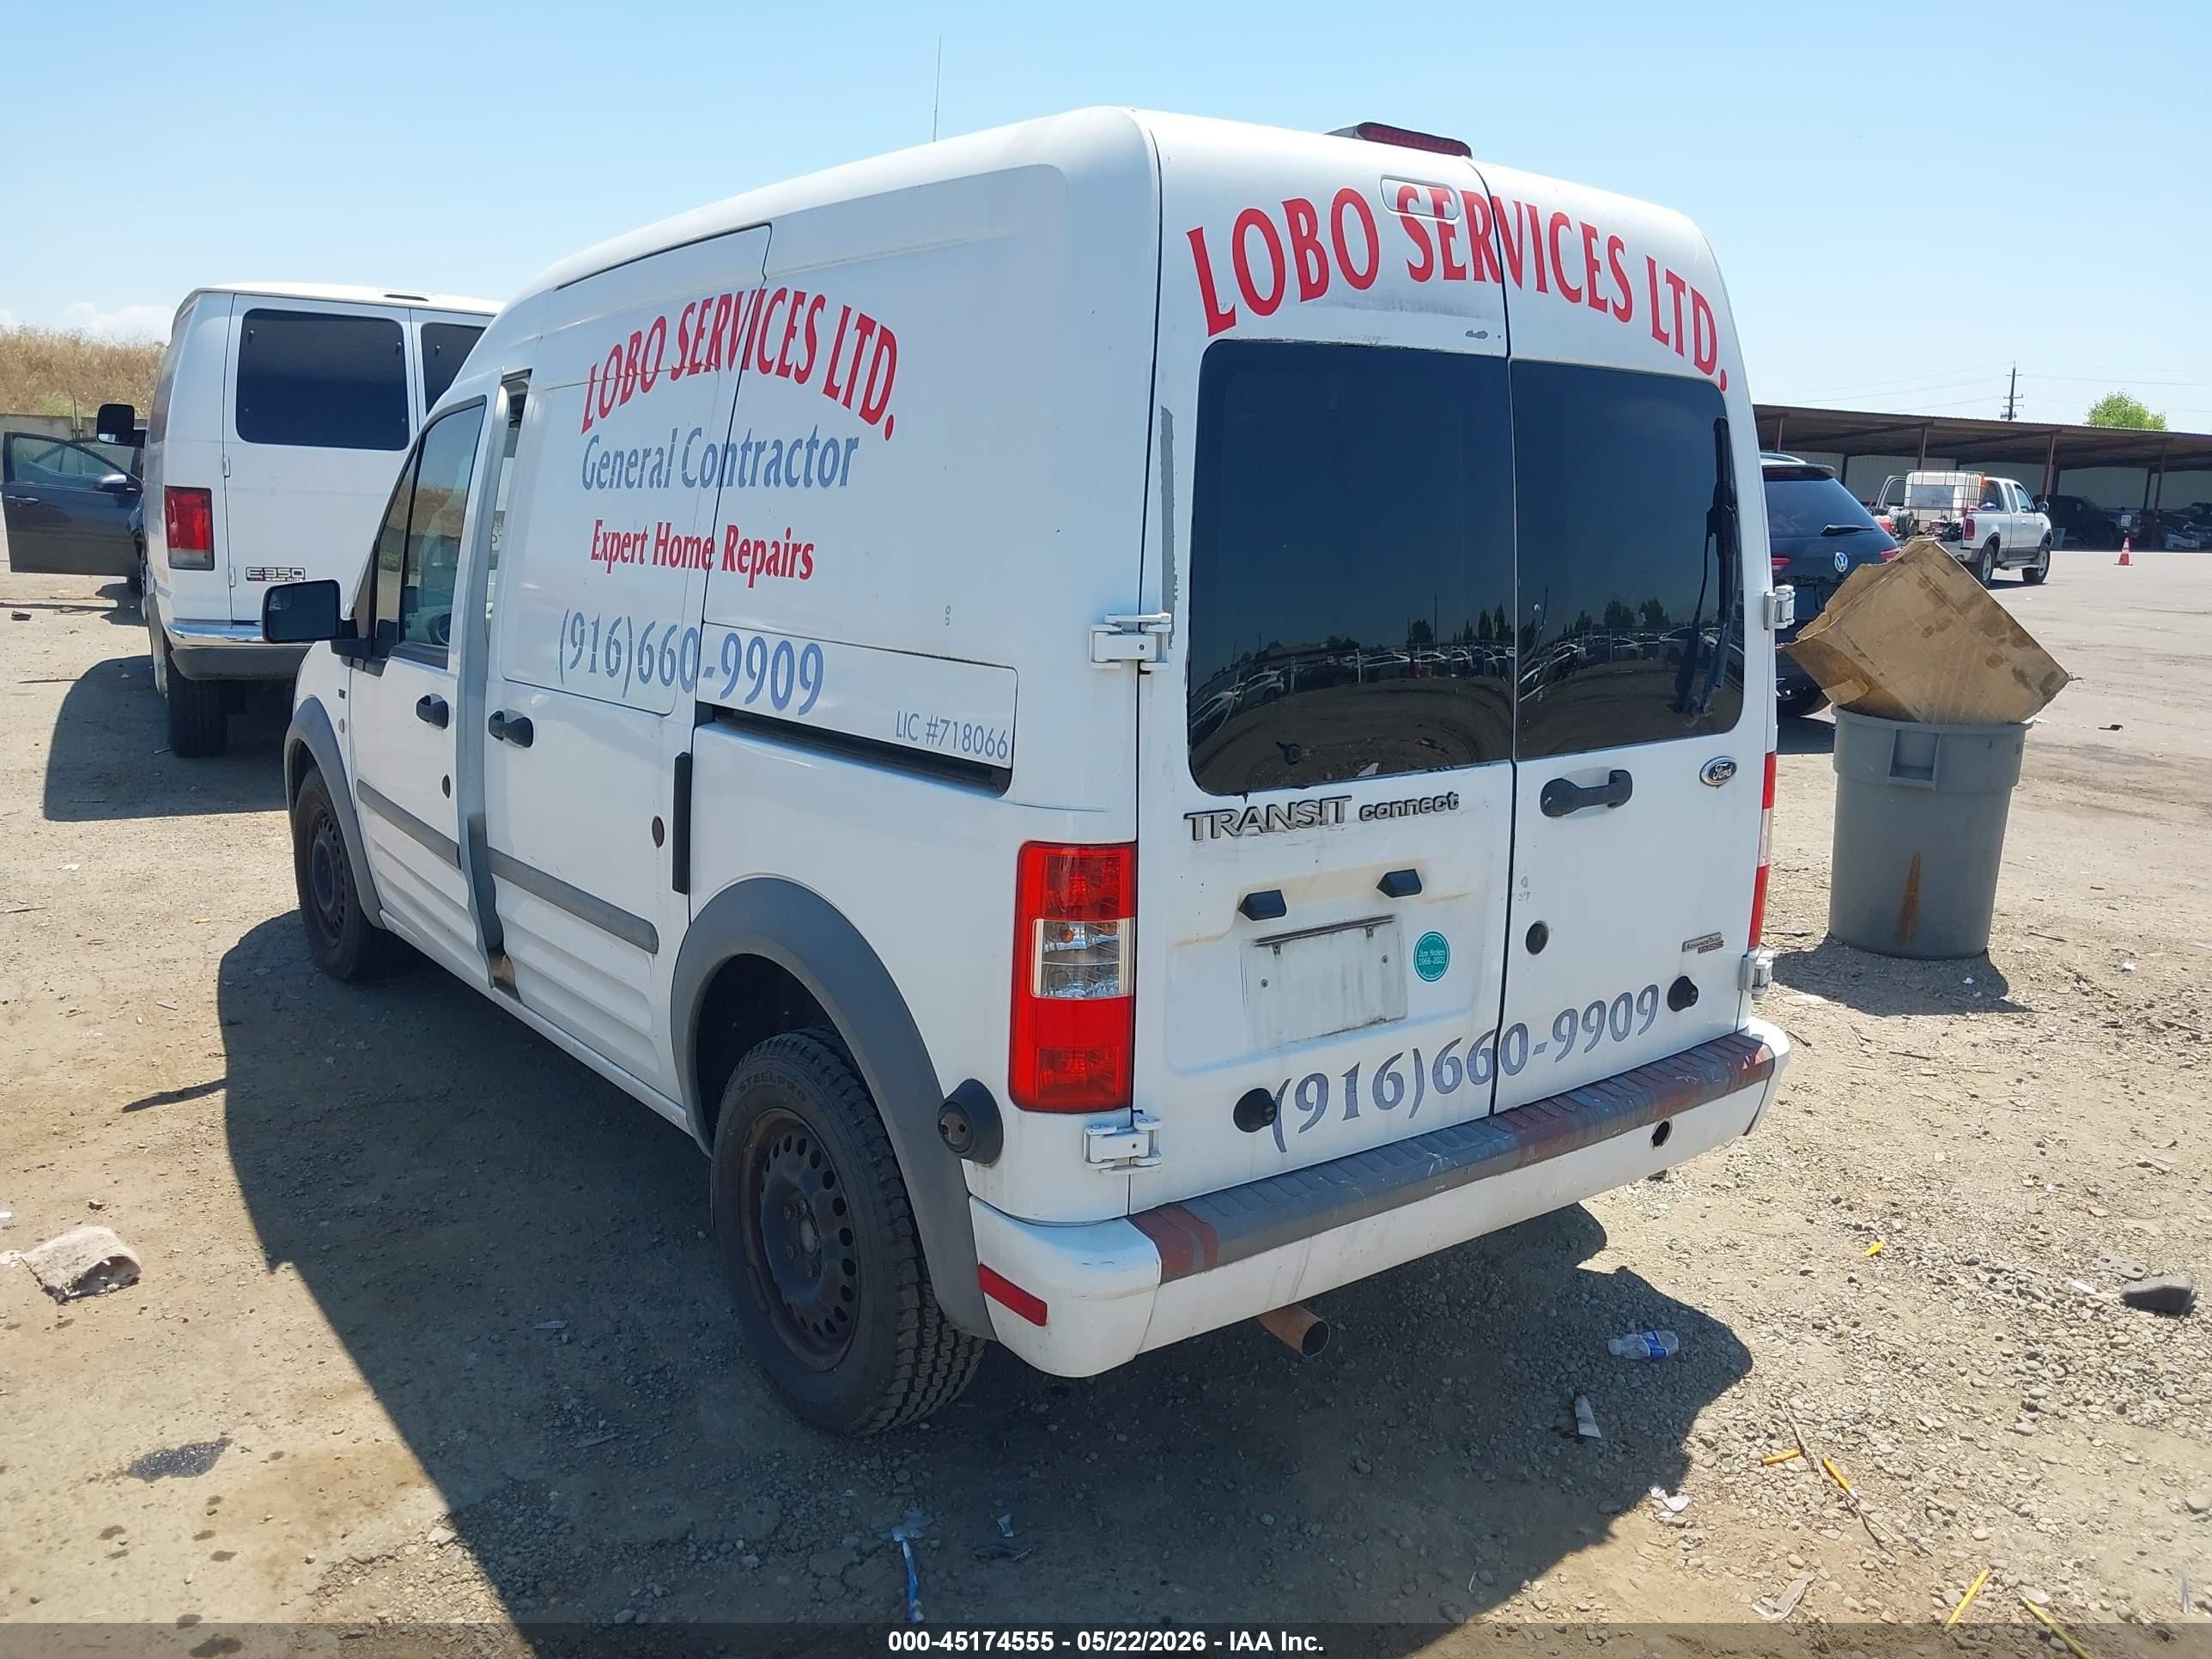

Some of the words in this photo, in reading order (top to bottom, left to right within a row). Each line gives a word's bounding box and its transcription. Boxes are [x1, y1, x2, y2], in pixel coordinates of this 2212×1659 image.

[1187, 186, 1379, 337] LOBO
[1396, 185, 1632, 324] SERVICES
[1645, 255, 1727, 392] LTD.
[580, 314, 667, 435] LOBO
[671, 287, 826, 385] SERVICES
[822, 304, 898, 441] LTD.
[580, 427, 678, 491] General
[681, 423, 860, 489] Contractor
[591, 518, 647, 574] Expert
[653, 521, 714, 571] Home
[721, 524, 815, 588] Repairs
[559, 608, 825, 716] (916)660-9909
[896, 710, 921, 742] LIC
[926, 714, 1008, 760] #718066
[1183, 795, 1352, 841] TRANSIT
[1359, 791, 1460, 822] connect
[1272, 984, 1659, 1153] (916)660-9909
